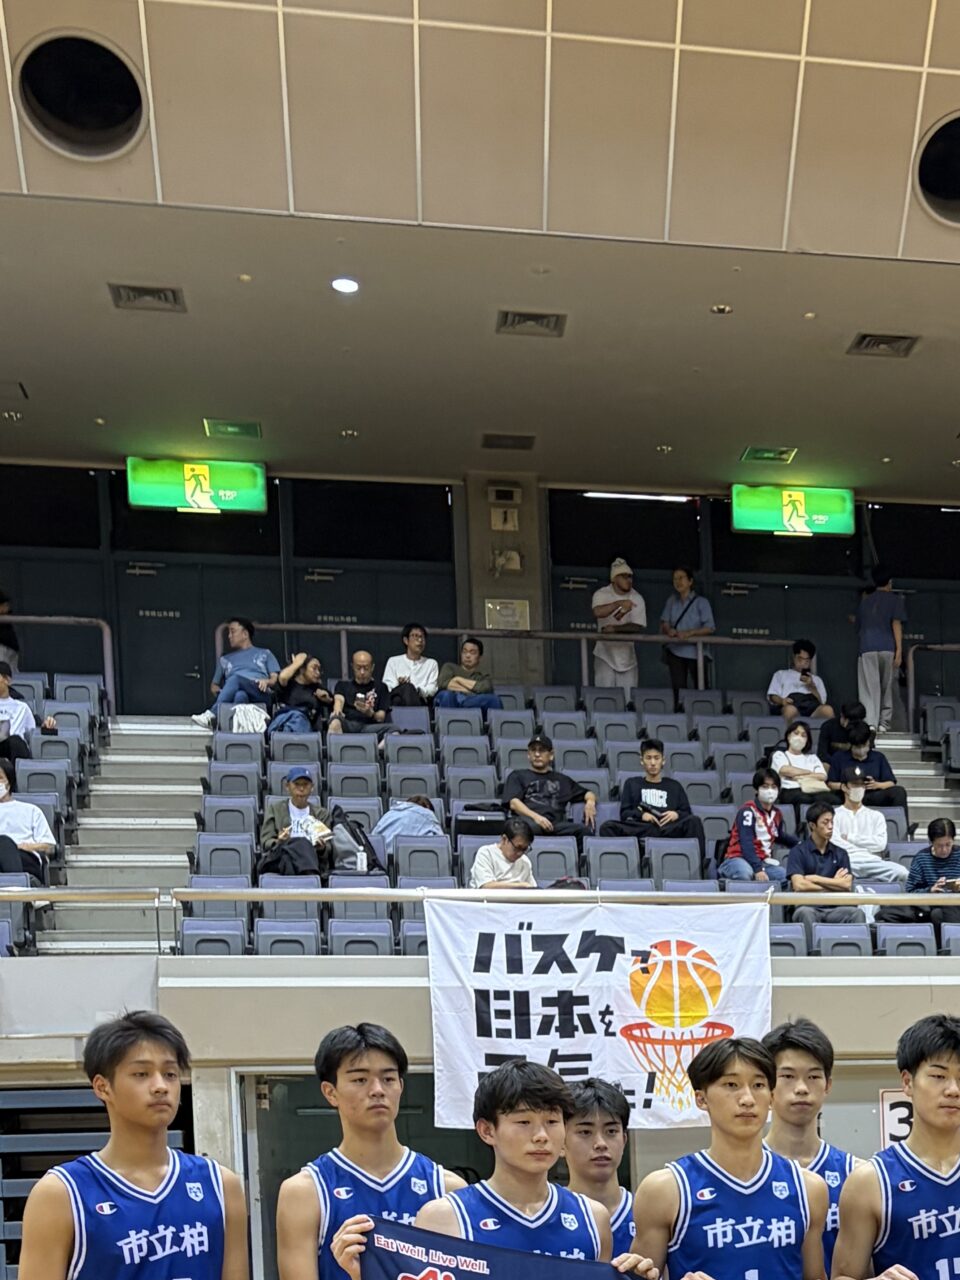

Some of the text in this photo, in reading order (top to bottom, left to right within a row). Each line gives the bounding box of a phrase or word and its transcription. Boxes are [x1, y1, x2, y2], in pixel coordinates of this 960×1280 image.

[743, 810, 753, 826] 3
[473, 988, 617, 1040] 日本を
[116, 1221, 210, 1265] 市立柏
[702, 1216, 796, 1249] 市立柏
[375, 1234, 397, 1252] Eat
[429, 1249, 457, 1268] Live
